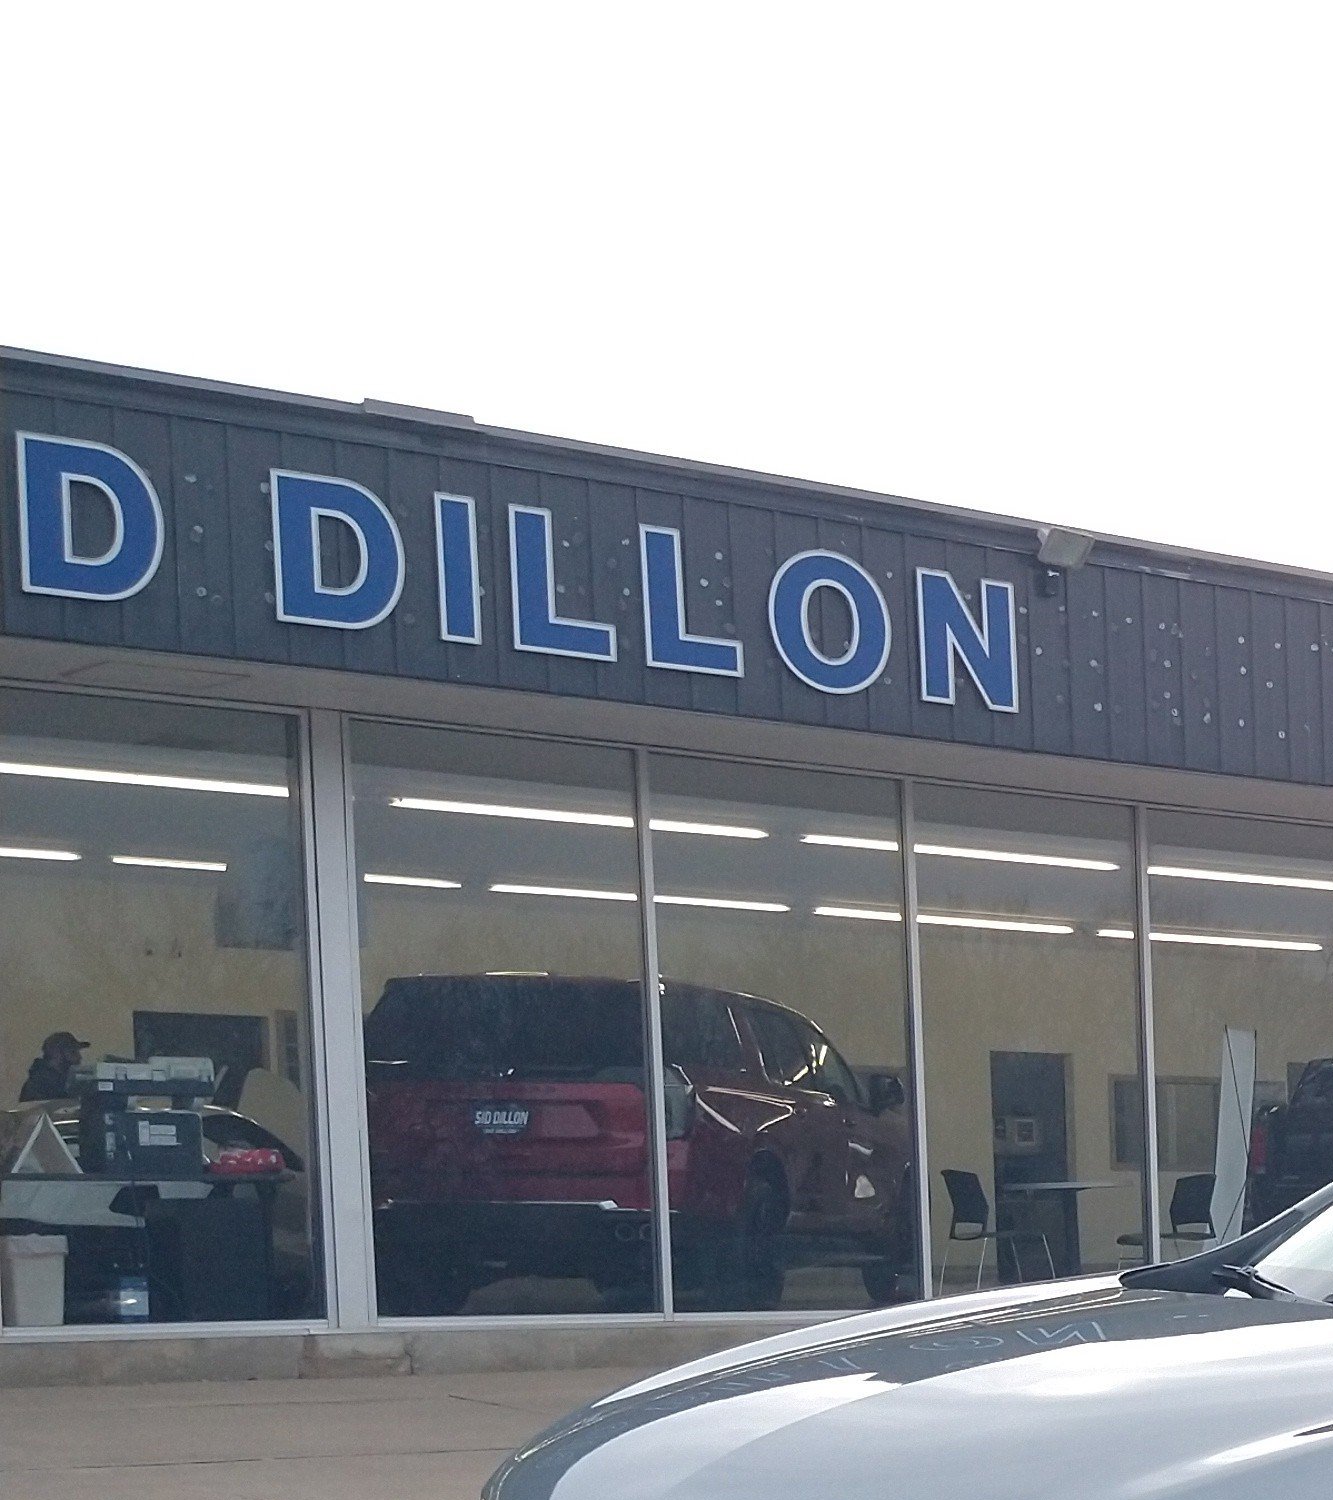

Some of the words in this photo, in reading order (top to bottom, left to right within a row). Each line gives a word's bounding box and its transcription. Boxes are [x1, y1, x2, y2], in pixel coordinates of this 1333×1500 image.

[268, 467, 1020, 714] DILLON
[474, 1110, 492, 1125] SID
[492, 1109, 529, 1125] DILLON
